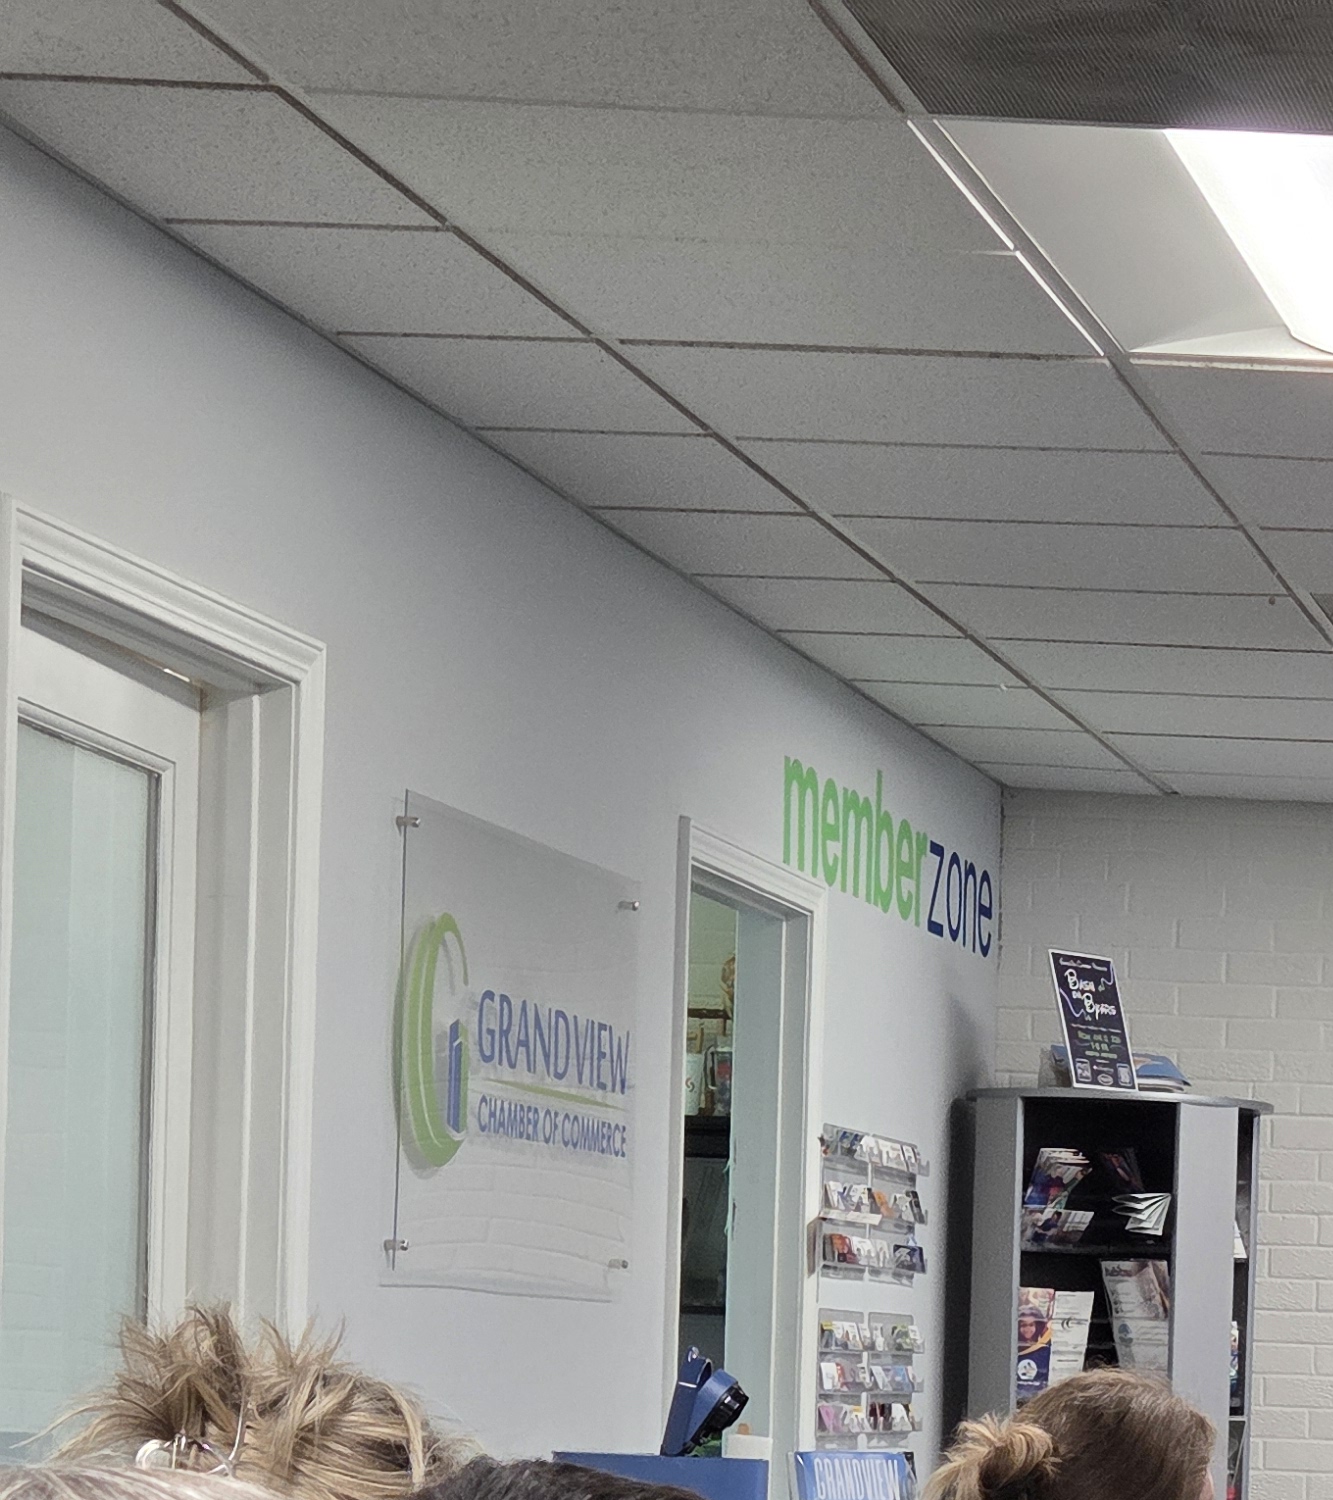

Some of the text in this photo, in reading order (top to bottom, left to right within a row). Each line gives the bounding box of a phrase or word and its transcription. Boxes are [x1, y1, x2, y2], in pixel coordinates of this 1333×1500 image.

[478, 989, 630, 1095] GRANDVIEW
[478, 1094, 627, 1158] CHAMBER OF COMMERCE
